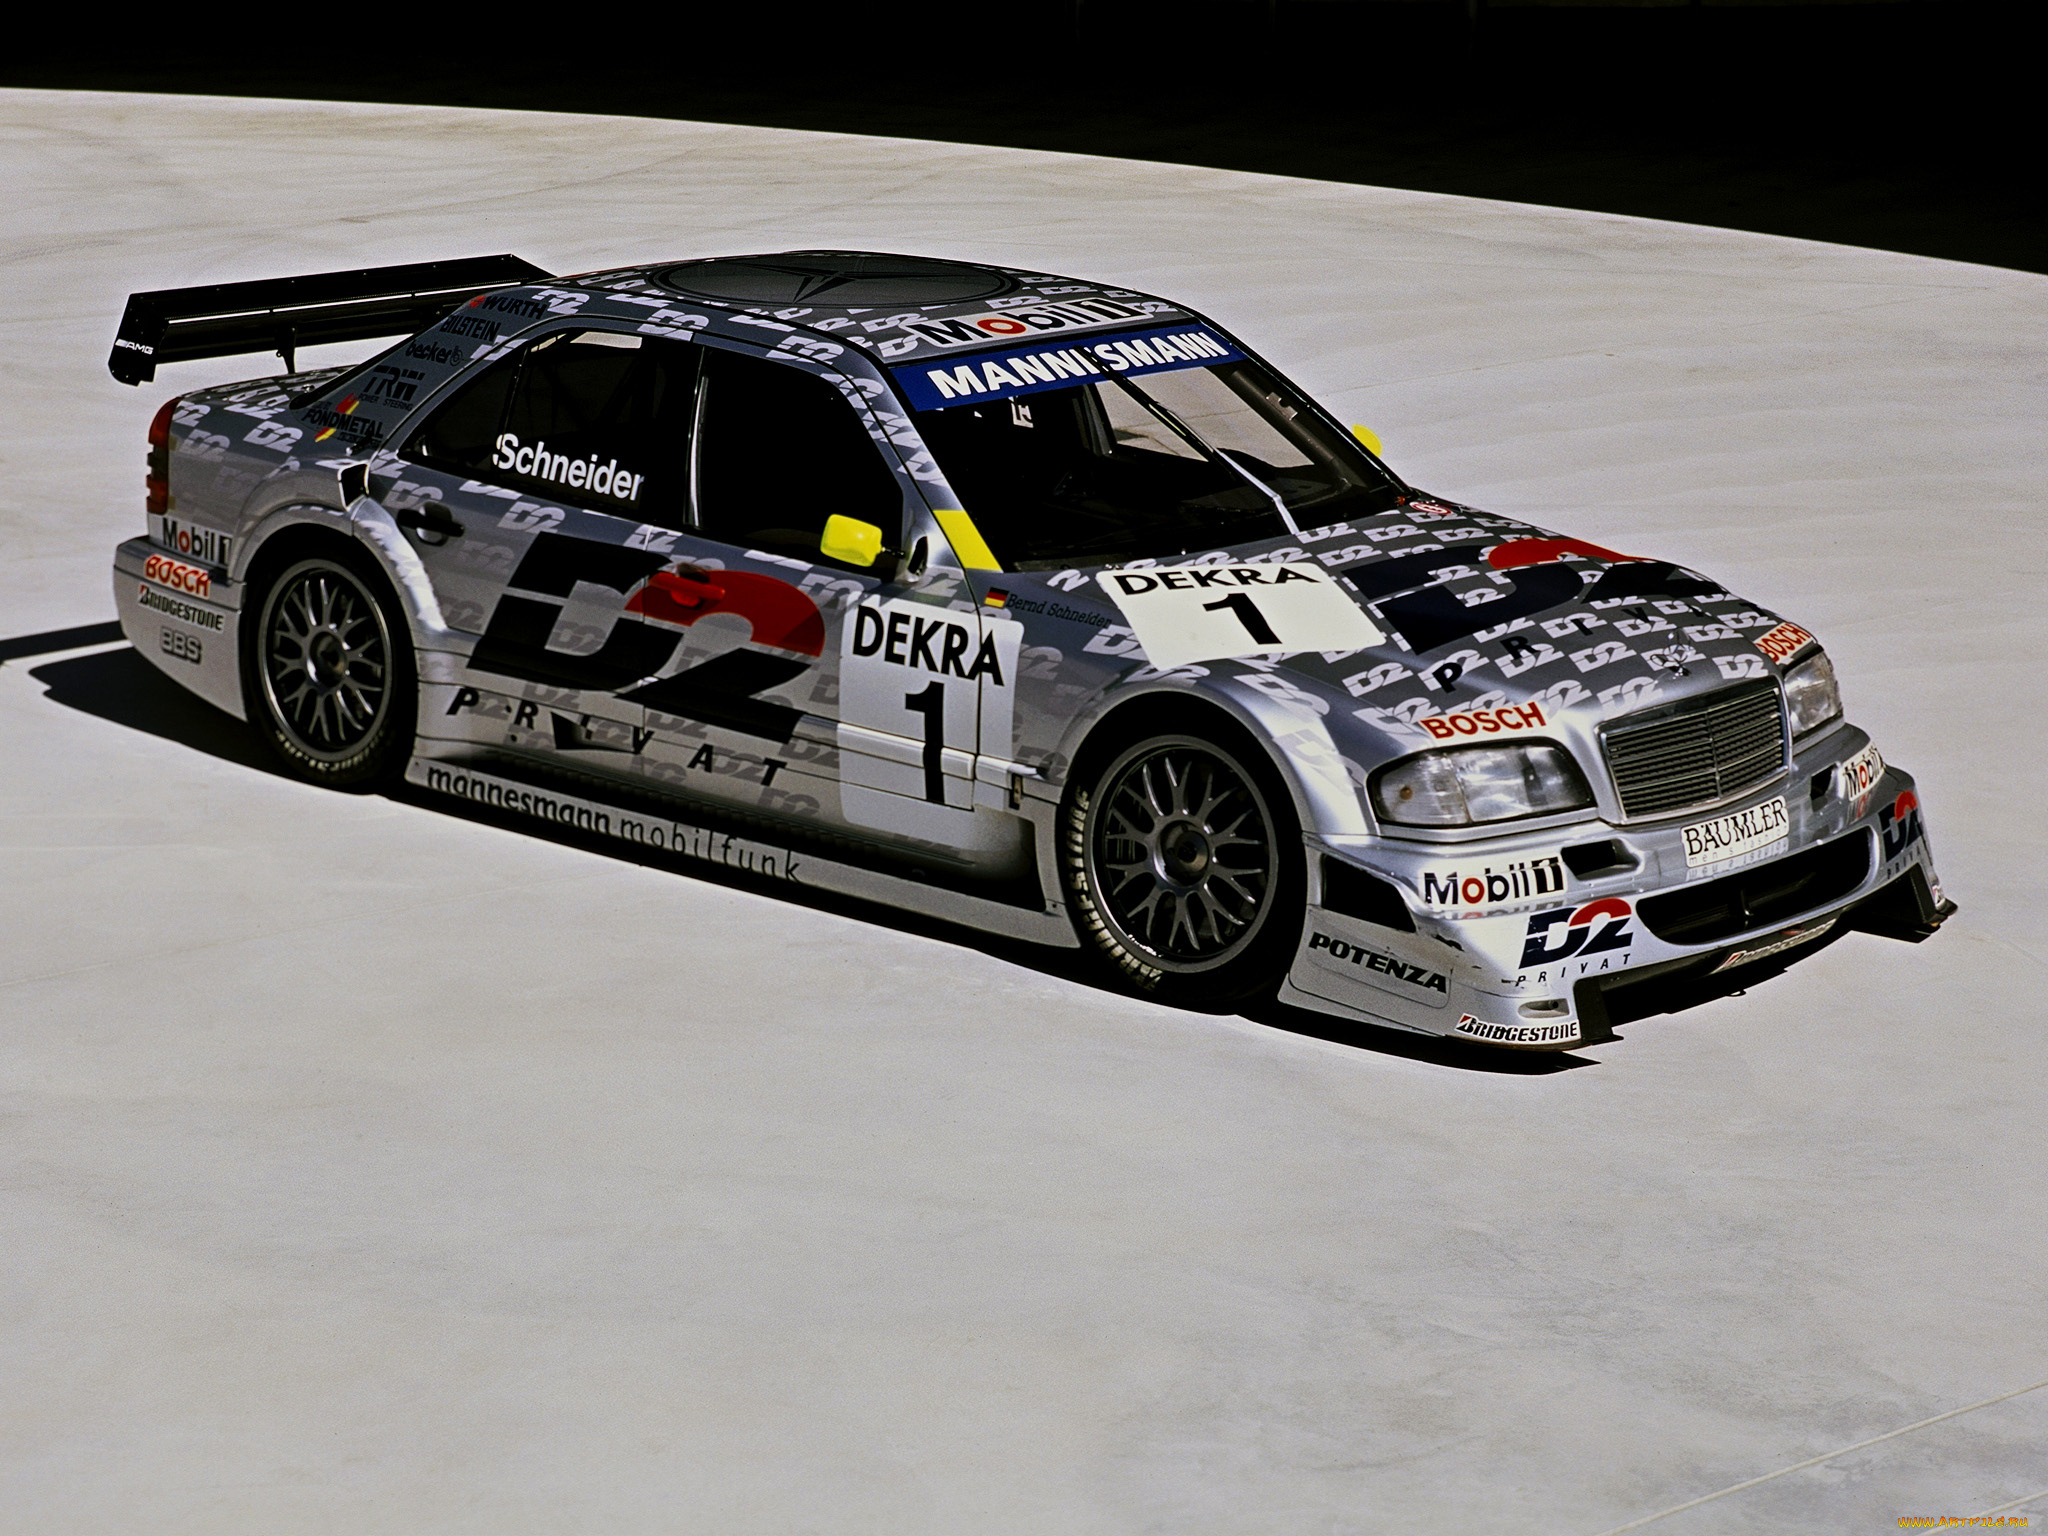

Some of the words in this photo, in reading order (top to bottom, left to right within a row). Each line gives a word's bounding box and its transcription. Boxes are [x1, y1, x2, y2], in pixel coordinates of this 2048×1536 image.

[985, 296, 1049, 309] D2
[440, 315, 502, 342] BILSTEIN
[909, 302, 1102, 345] Mobil
[126, 342, 154, 355] AMG
[405, 340, 453, 364] becker
[383, 398, 413, 411] STEERING
[243, 420, 303, 453] D2
[301, 408, 384, 439] FONDMETAL
[178, 429, 230, 463] D2
[493, 433, 644, 501] Schneider
[497, 501, 566, 533] D2
[1363, 524, 1427, 542] D2
[162, 517, 215, 562] Mobil
[1432, 527, 1494, 542] D2
[1317, 545, 1383, 567] D2
[145, 554, 211, 597] BOSCH
[1112, 567, 1321, 596] DEKRA
[140, 584, 224, 631] BRIDGESTONE
[1006, 593, 1047, 614] Bernd
[1047, 603, 1113, 629] Schneider
[1202, 592, 1283, 645] 1
[1717, 611, 1778, 629] D2
[466, 531, 826, 744] D2
[1613, 616, 1678, 637] D2
[1683, 623, 1744, 643] D2
[161, 626, 202, 664] BBS
[852, 604, 1005, 687] DEKRA
[1568, 641, 1637, 673] D2
[1342, 662, 1413, 697] D2
[1711, 654, 1769, 679] D2
[1420, 701, 1547, 740] BOSCH
[905, 680, 945, 805] 1
[427, 764, 611, 832] mannesmann
[620, 817, 801, 883] mobilfunk
[1683, 798, 1787, 857] BÄUMLER
[1424, 862, 1530, 905] Mobil
[1518, 897, 1634, 970] D2
[1308, 932, 1447, 994] POTENZA
[1514, 953, 1631, 988] PRIVAT
[1455, 1013, 1578, 1041] BRIDGESTONE
